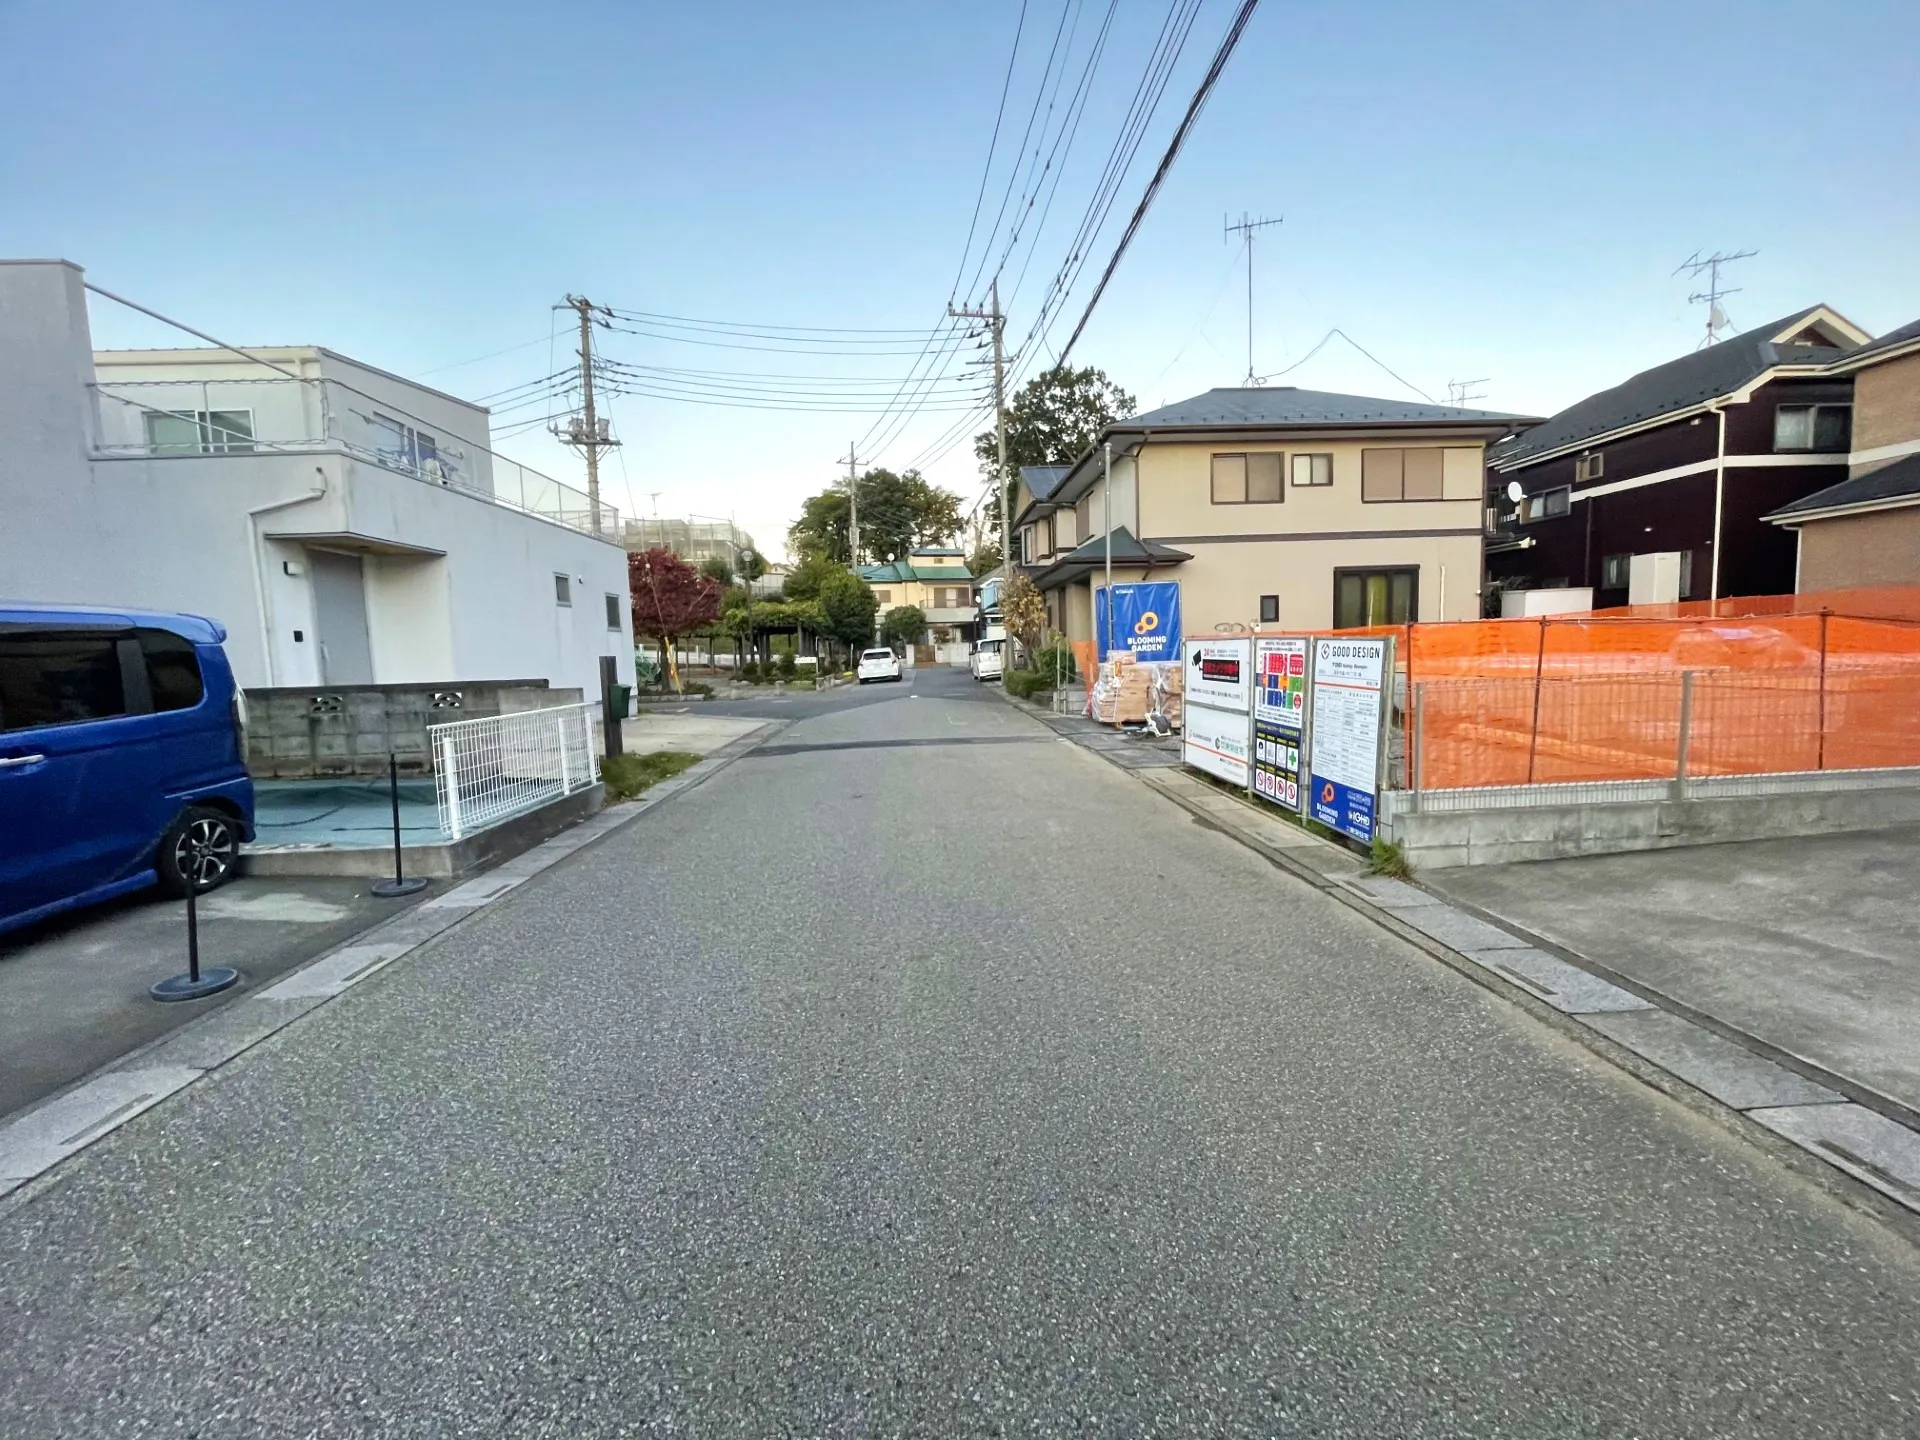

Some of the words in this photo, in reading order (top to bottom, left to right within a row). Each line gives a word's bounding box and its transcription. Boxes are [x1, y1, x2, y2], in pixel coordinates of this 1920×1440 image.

[1127, 636, 1167, 645] BLOOMING
[1131, 644, 1163, 652] GARDEN
[1332, 646, 1351, 657] GOOD
[1352, 647, 1380, 659] DESIGN
